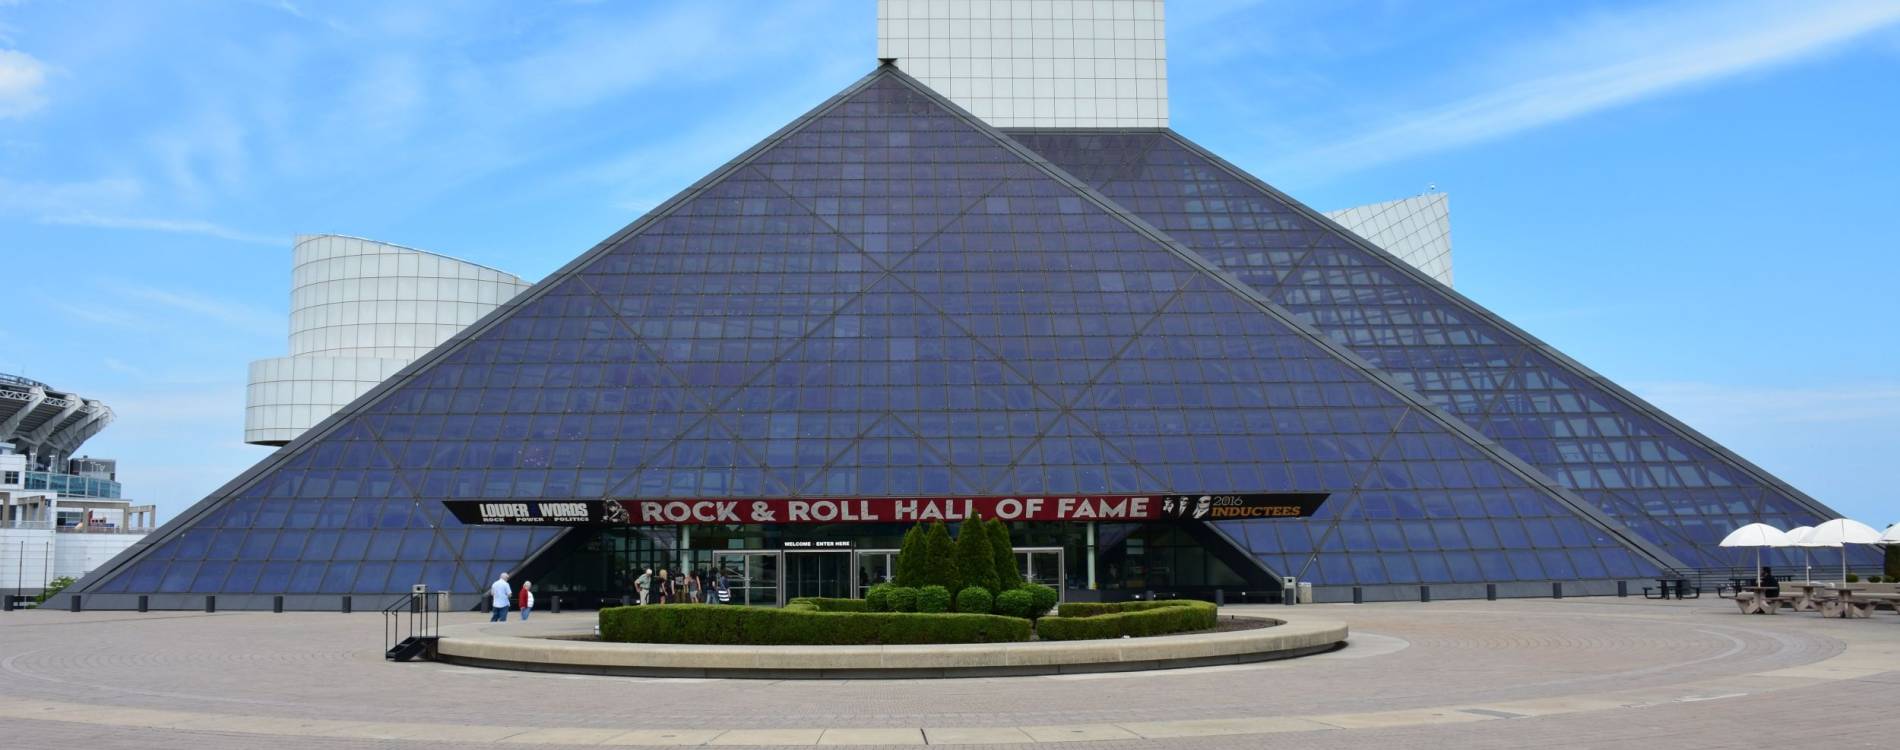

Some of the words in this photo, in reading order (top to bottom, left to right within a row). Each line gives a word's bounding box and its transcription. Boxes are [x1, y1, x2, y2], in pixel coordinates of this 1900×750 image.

[1213, 496, 1243, 506] 2016
[479, 503, 530, 518] LOUDER
[538, 503, 588, 517] WORDS
[641, 501, 741, 522] ROCK
[751, 501, 776, 521] &
[789, 501, 879, 522] ROLL
[895, 500, 982, 520] HALL
[996, 499, 1044, 519] OF
[1057, 498, 1150, 518] FAME
[1212, 506, 1301, 517] INDUCTEES
